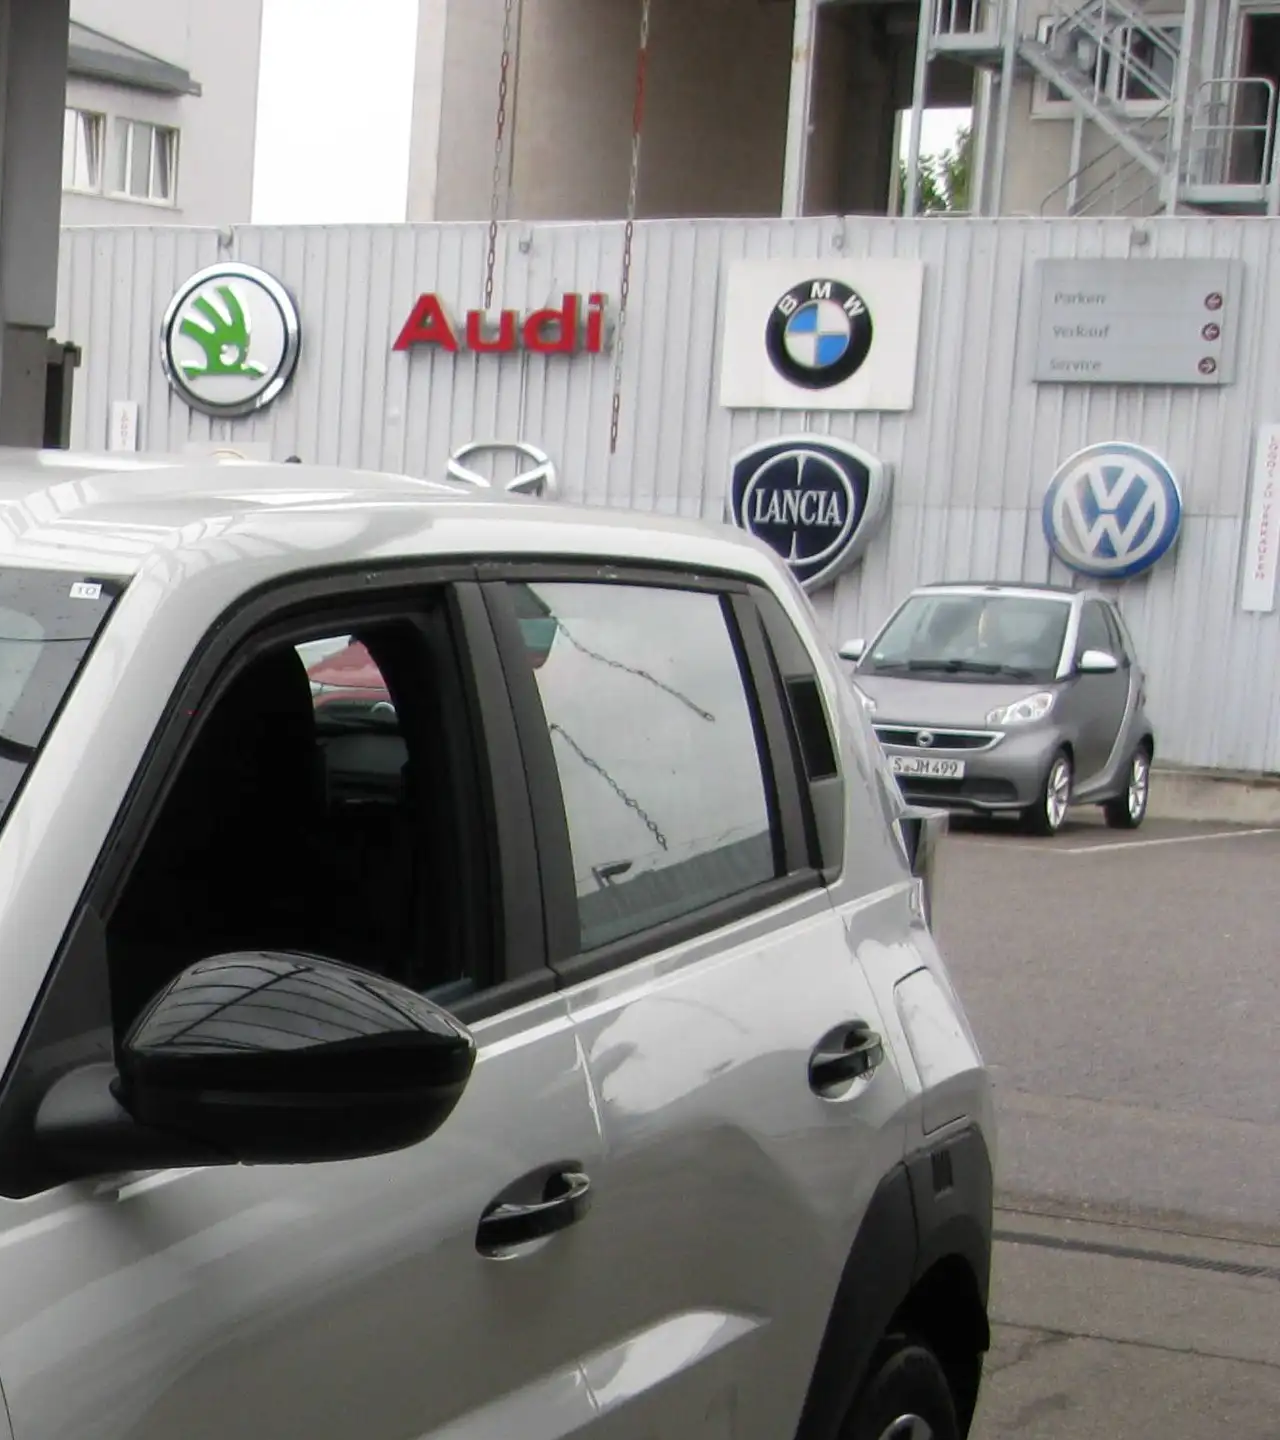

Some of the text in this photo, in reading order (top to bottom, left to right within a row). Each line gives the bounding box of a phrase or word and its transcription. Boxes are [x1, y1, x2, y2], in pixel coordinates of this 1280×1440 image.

[776, 280, 868, 320] BMW
[1053, 291, 1107, 308] Parken
[392, 291, 608, 353] Audi
[1051, 323, 1110, 341] Verkauf
[1048, 357, 1102, 374] Service
[753, 487, 844, 526] LANCIA
